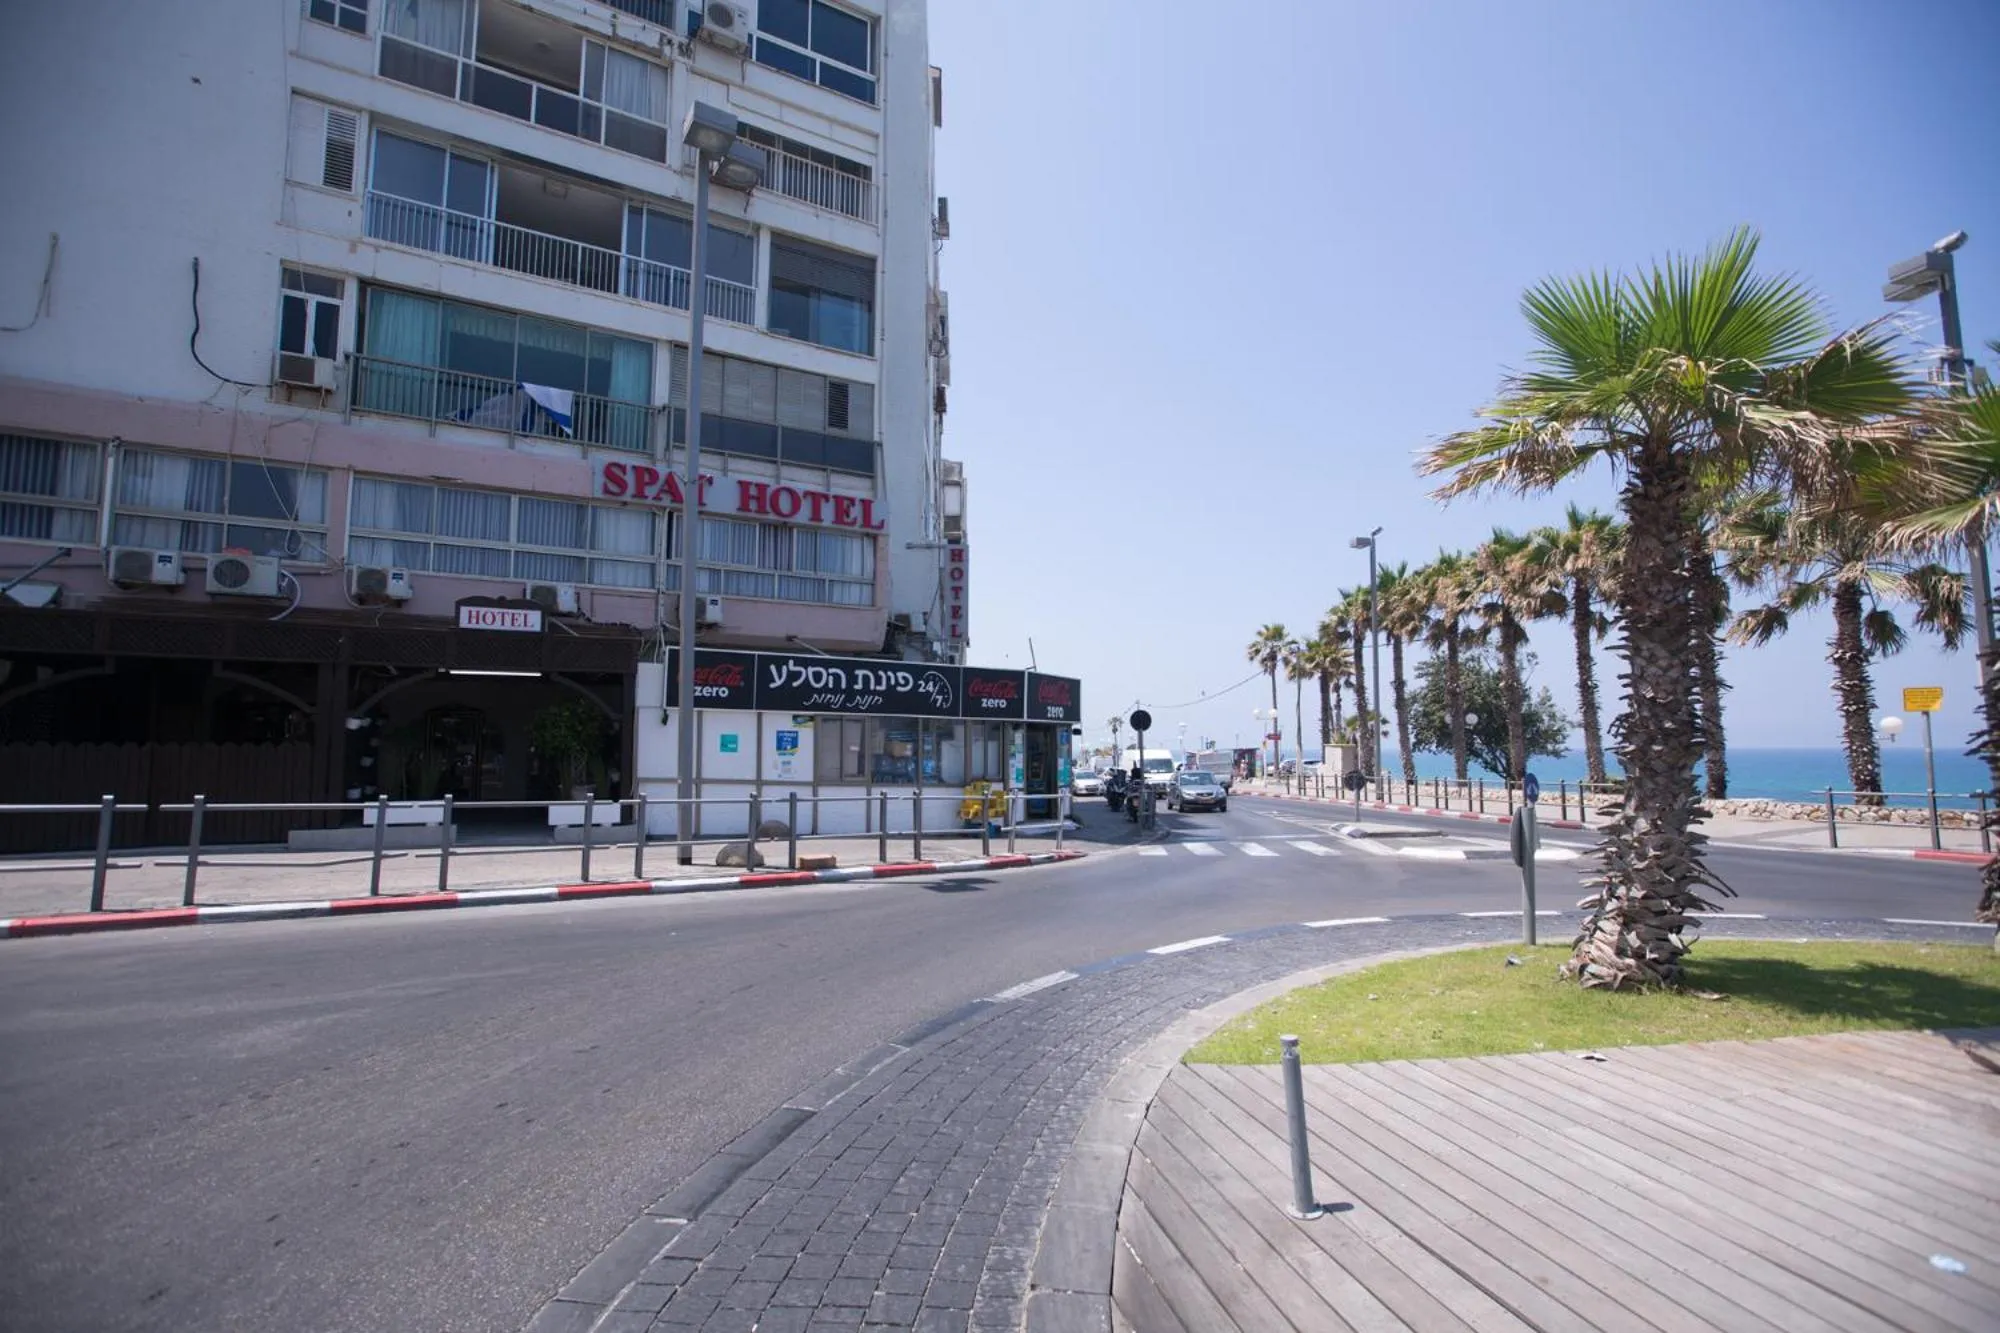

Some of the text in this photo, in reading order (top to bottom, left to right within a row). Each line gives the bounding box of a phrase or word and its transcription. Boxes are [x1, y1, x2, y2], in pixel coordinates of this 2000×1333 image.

[737, 479, 885, 530] HOTEL
[950, 548, 965, 638] HOTEL
[467, 609, 535, 628] HOTEL
[769, 659, 914, 692] פינת הסלע
[693, 685, 729, 698] zero
[846, 694, 883, 709] חנות
[981, 698, 1007, 708] zero
[1046, 706, 1065, 718] zero
